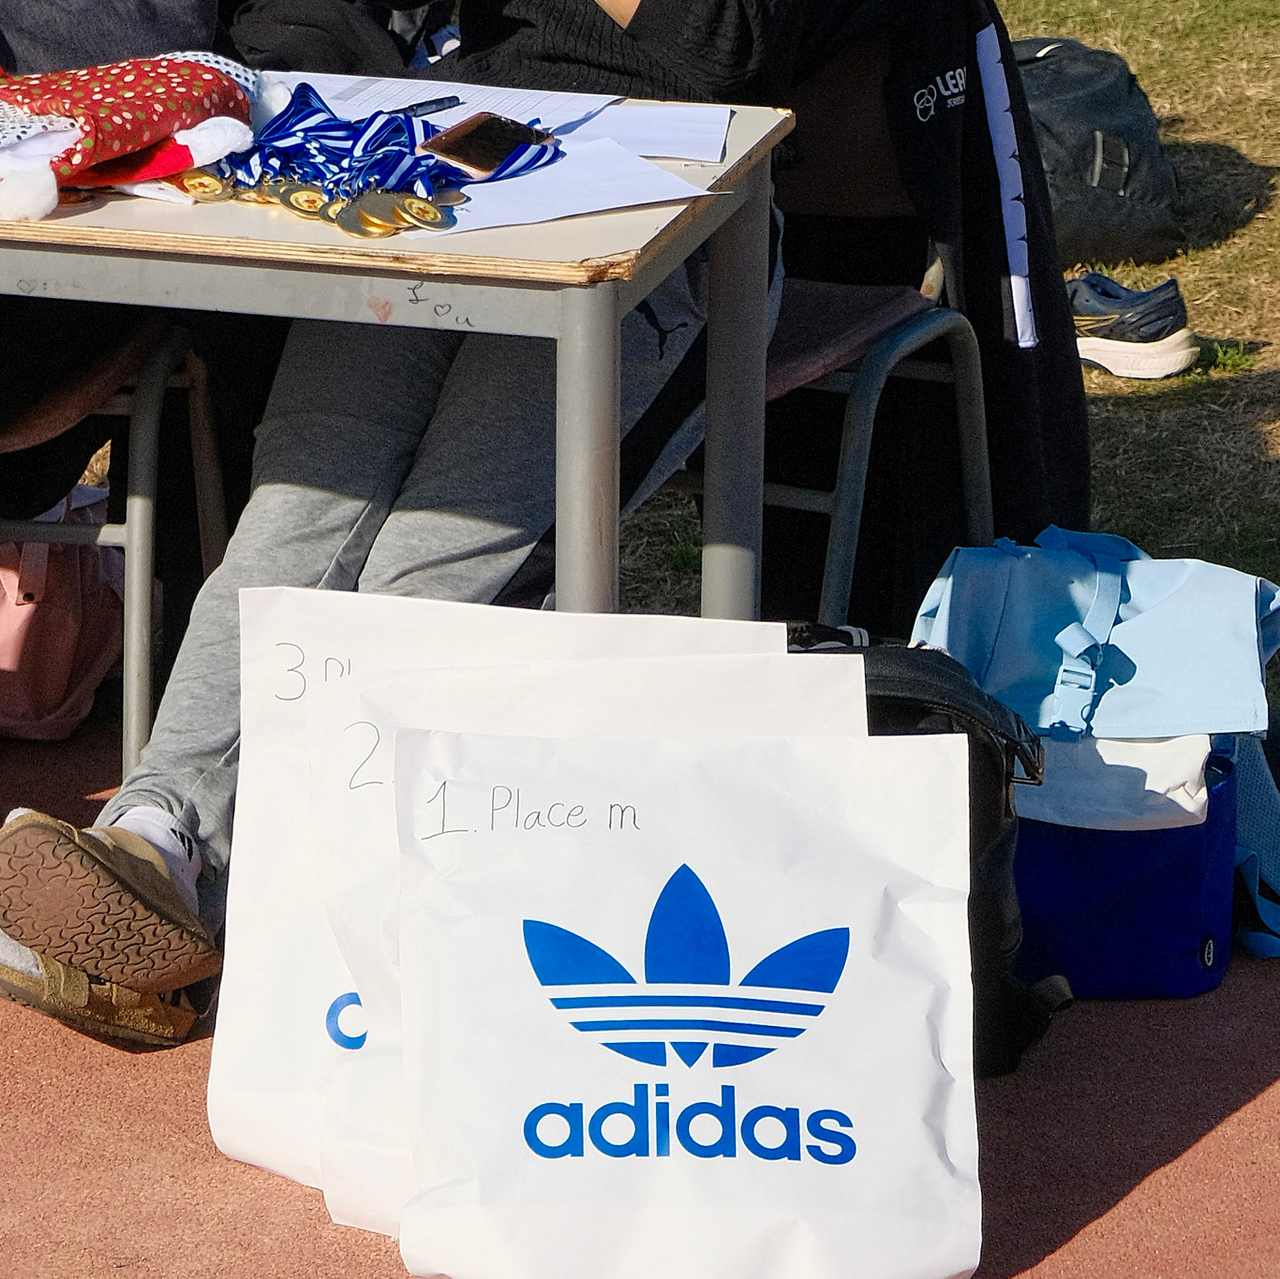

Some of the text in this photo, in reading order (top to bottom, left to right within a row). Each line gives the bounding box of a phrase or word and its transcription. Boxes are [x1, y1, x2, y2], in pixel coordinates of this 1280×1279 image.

[420, 780, 641, 841] 1. Place m
[524, 1084, 856, 1164] adidas
